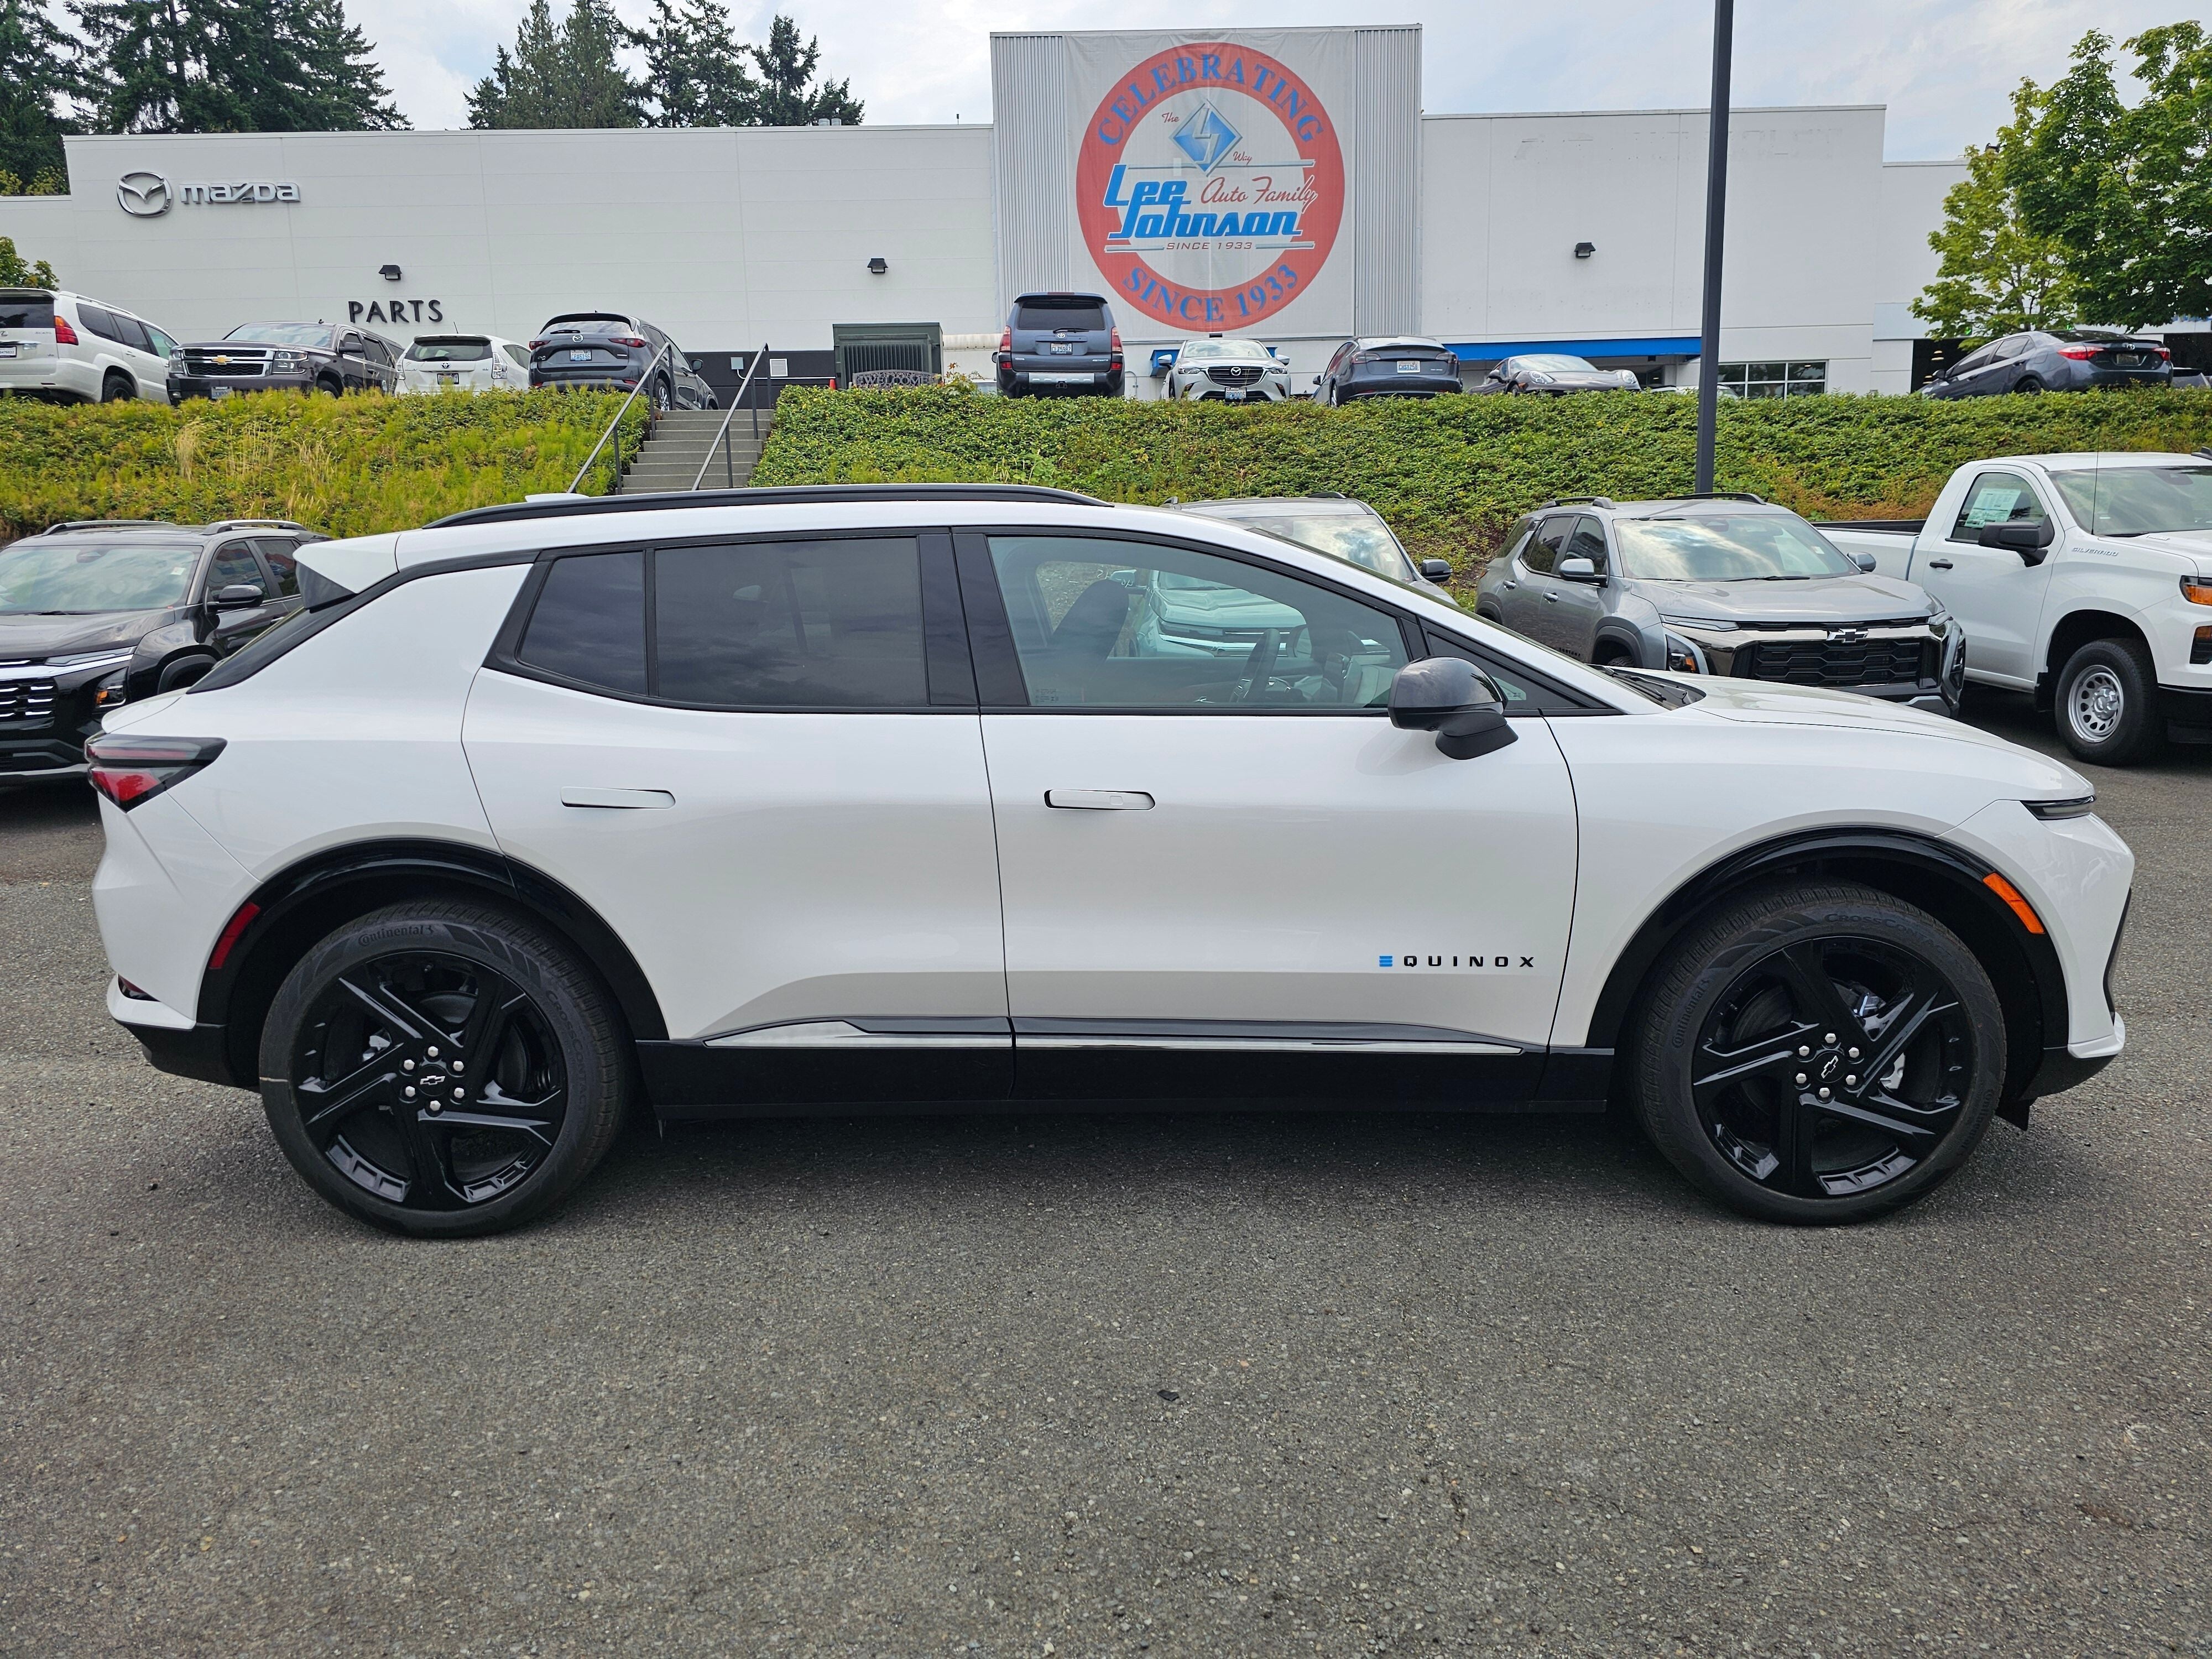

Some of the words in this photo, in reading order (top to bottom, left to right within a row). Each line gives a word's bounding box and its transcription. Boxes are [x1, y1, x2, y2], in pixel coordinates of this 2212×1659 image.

[1098, 54, 1324, 146] CELEBRATING
[1162, 112, 1180, 123] The
[1233, 152, 1252, 165] Way
[1104, 164, 1191, 206] Lee
[1201, 177, 1248, 204] Auto
[1252, 175, 1318, 213] Family
[1108, 196, 1303, 239] Johnson
[348, 300, 442, 323] PARTS
[1122, 268, 1224, 322] SINCE
[1237, 264, 1297, 317] 1933
[864, 376, 928, 385] WELCOME
[2072, 547, 2119, 557] SILVERADO
[358, 925, 423, 946] Continental
[1379, 956, 1534, 967] EQUINOX
[1672, 986, 1707, 1048] Continental
